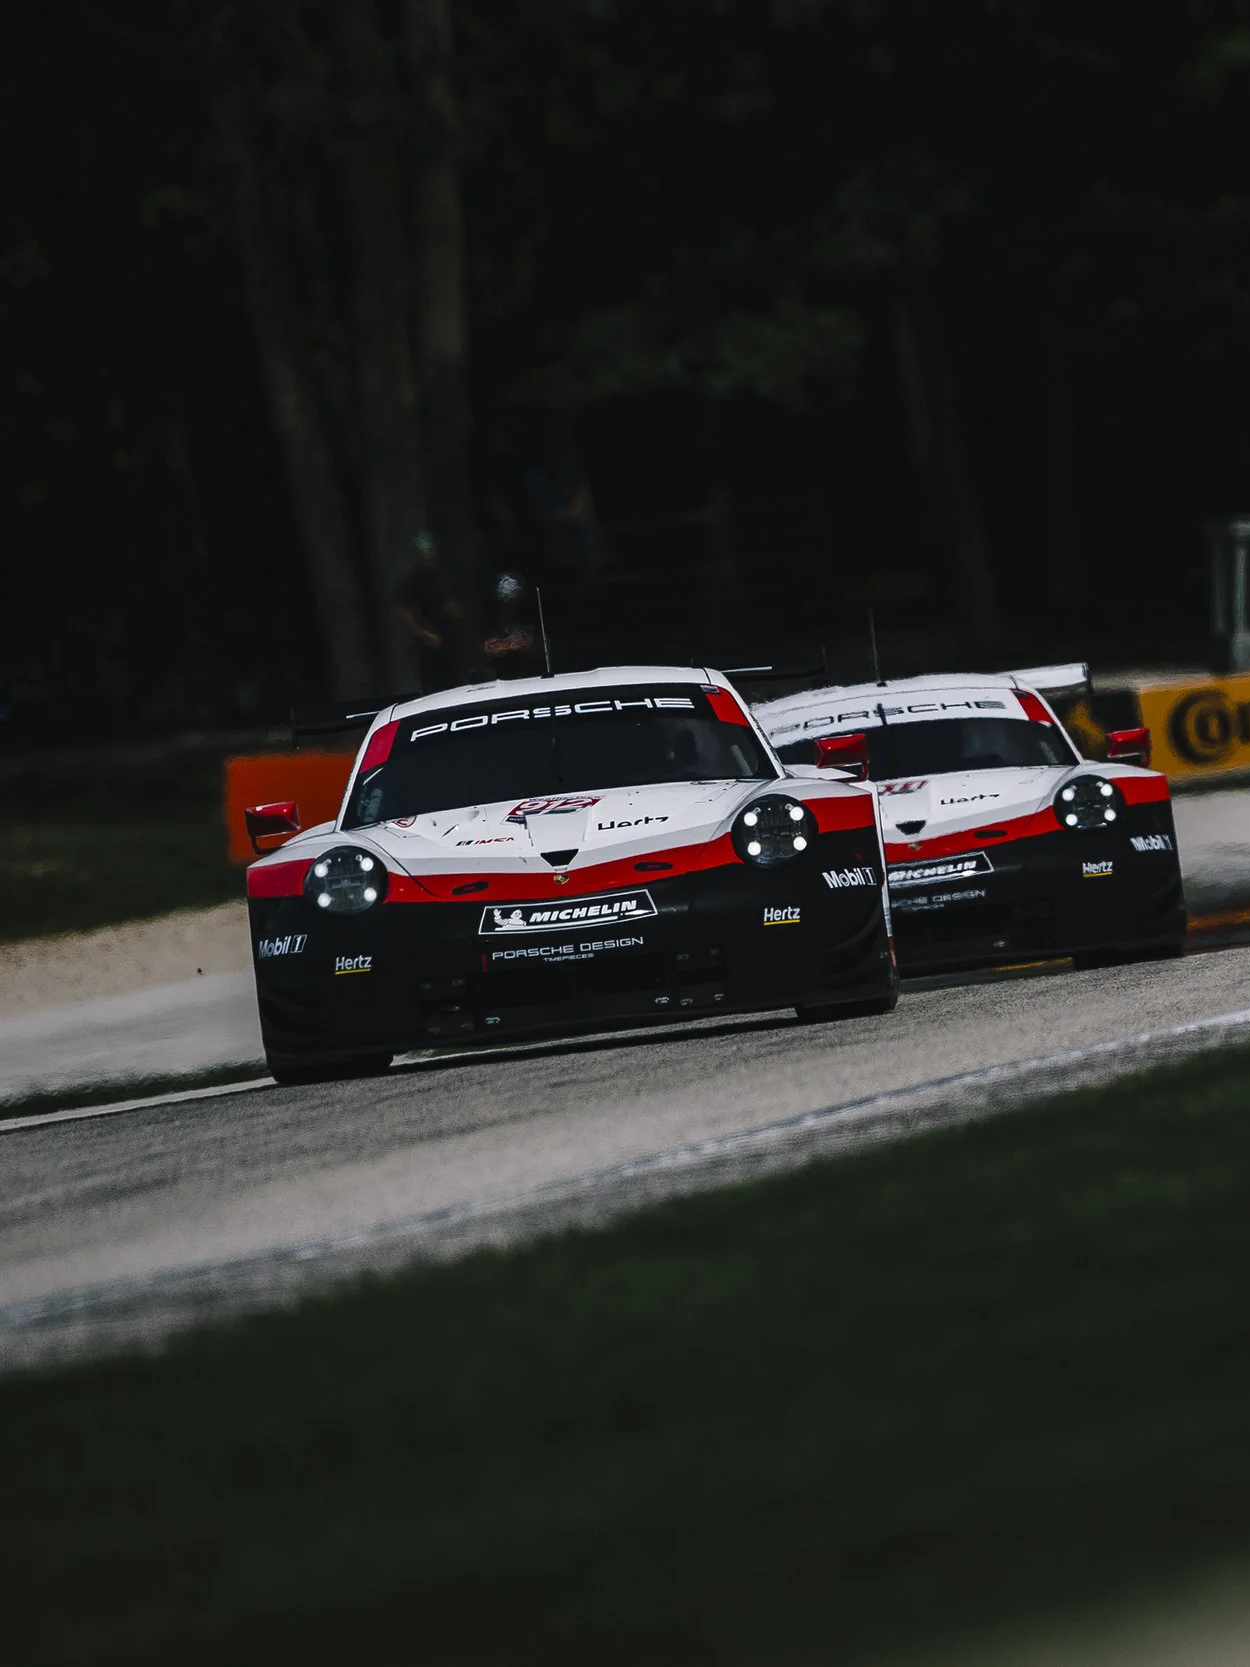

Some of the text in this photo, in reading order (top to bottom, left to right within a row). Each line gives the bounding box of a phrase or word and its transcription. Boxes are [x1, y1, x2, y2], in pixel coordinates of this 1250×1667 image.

[410, 698, 695, 742] PORSCHE
[769, 700, 1006, 736] PORSCHE
[822, 867, 866, 889] Mobil
[1082, 861, 1114, 874] Hertz
[529, 899, 637, 923] MICHELIN
[763, 906, 801, 922] Hertz
[258, 935, 292, 959] Mobil
[492, 936, 645, 961] PORSCHE DESIGN
[543, 952, 594, 963] TIMEPIECES
[335, 954, 373, 972] Hertz
